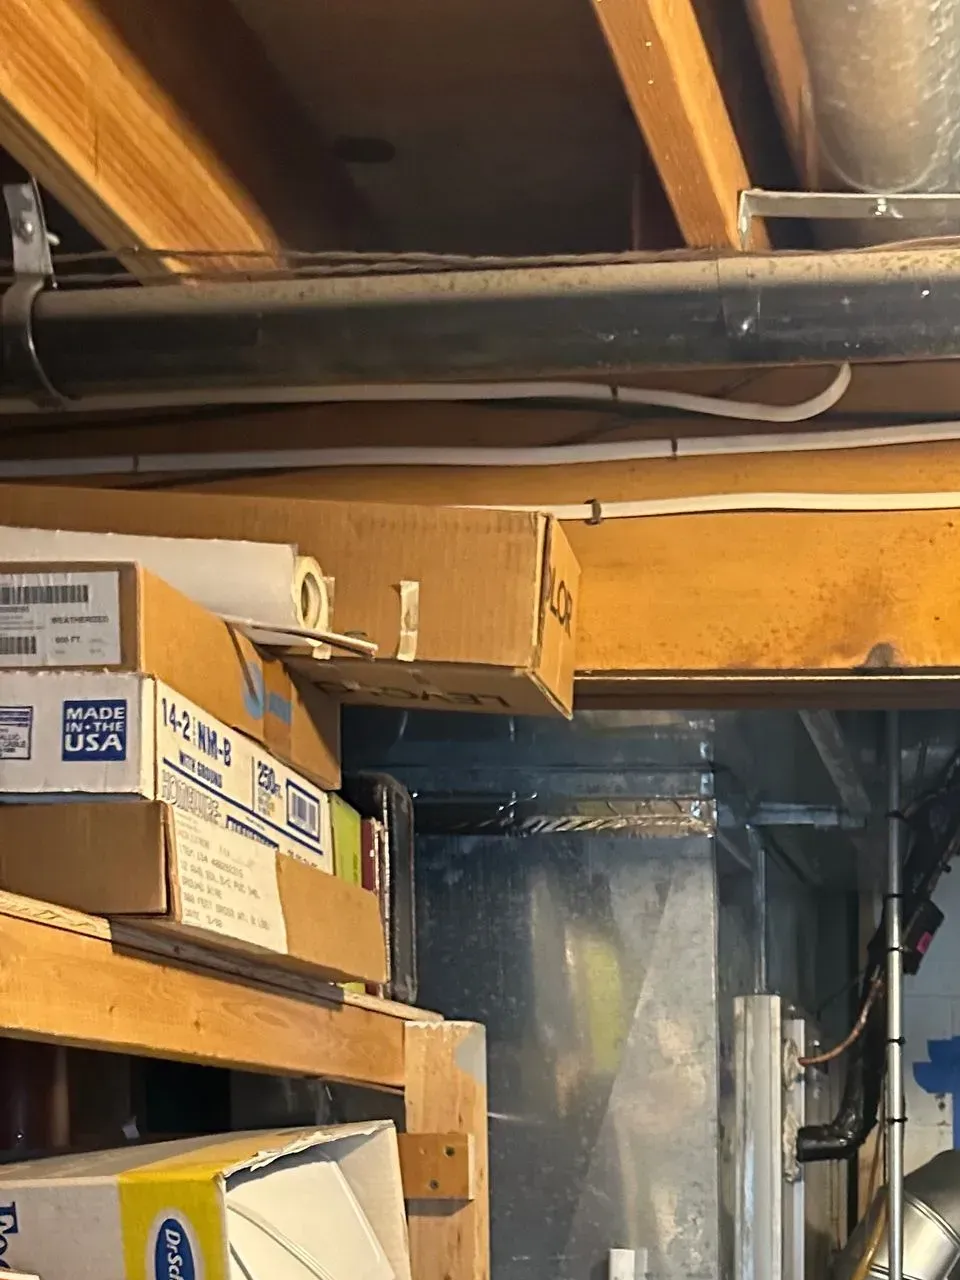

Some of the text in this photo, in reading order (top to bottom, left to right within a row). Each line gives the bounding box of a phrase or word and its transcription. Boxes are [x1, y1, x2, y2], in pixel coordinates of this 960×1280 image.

[66, 707, 125, 720] MADE
[162, 698, 190, 741] 14-2
[64, 734, 123, 752] USA
